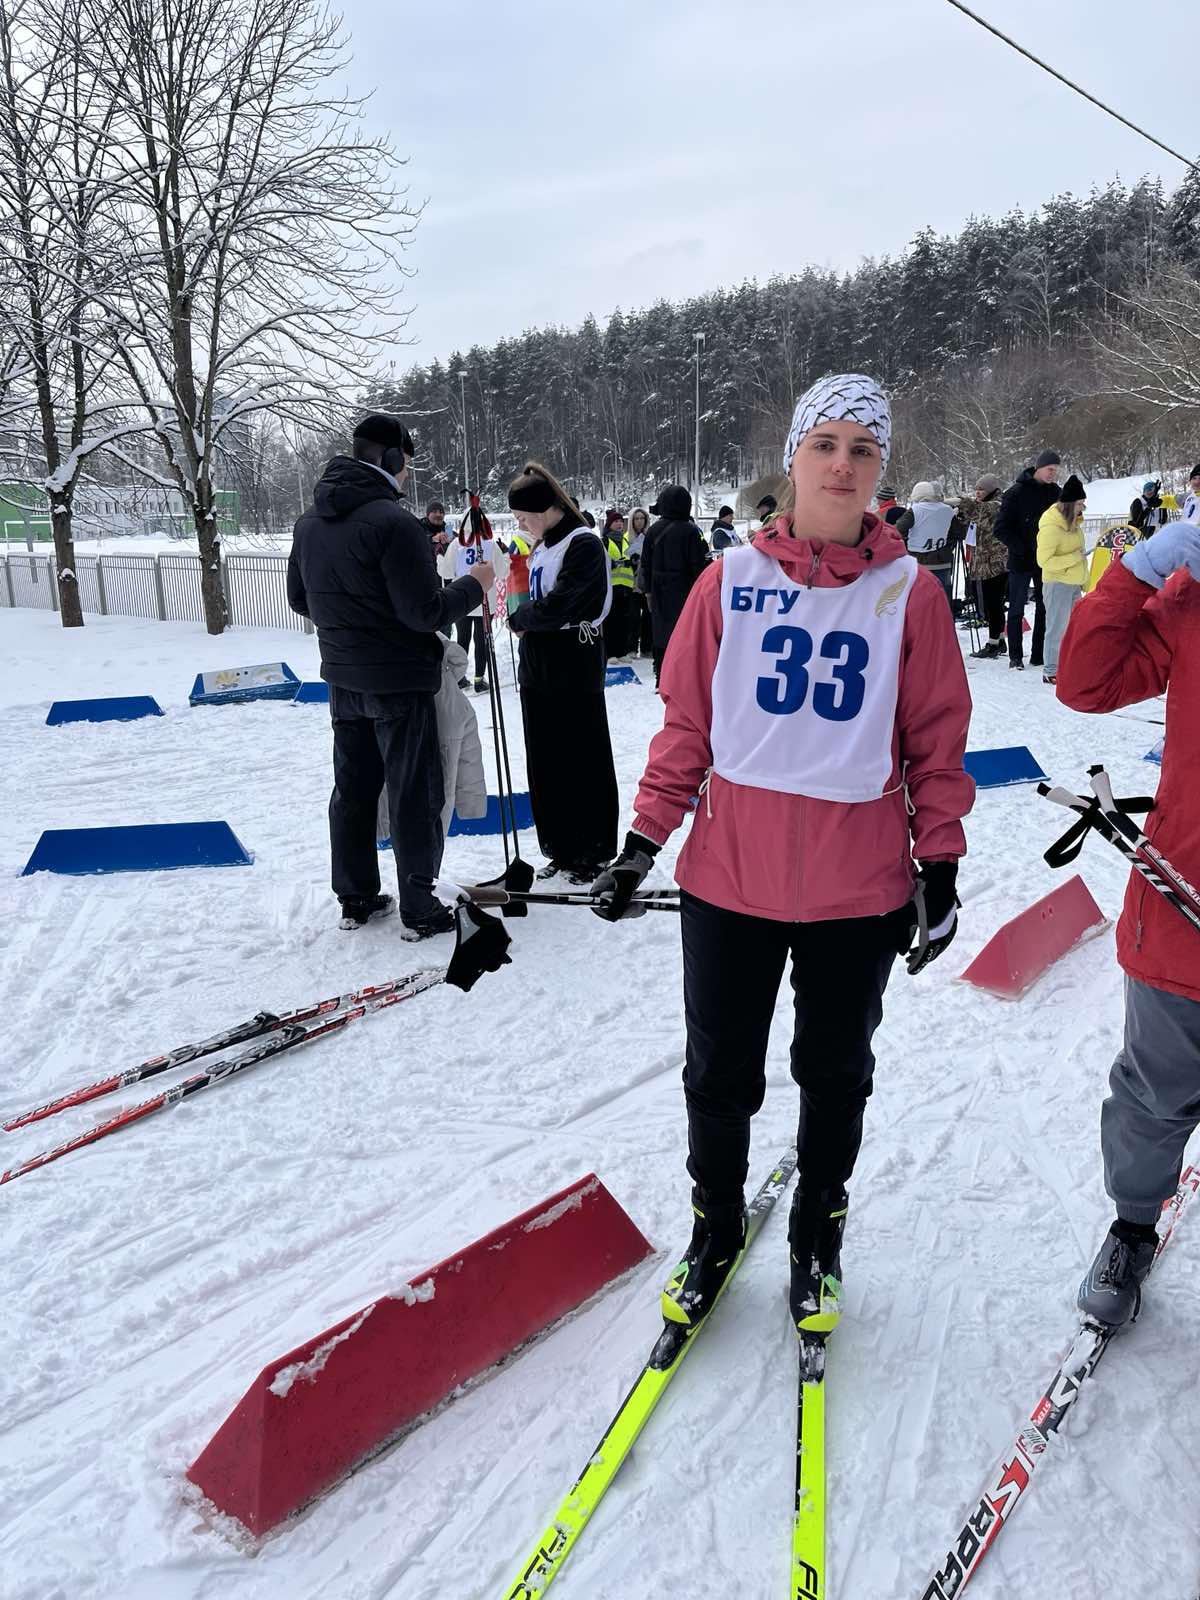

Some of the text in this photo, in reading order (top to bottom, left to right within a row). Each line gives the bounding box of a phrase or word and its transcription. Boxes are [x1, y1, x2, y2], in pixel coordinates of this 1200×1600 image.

[731, 585, 801, 615] БГУ
[755, 625, 870, 722] 33
[797, 1560, 819, 1600] FI
